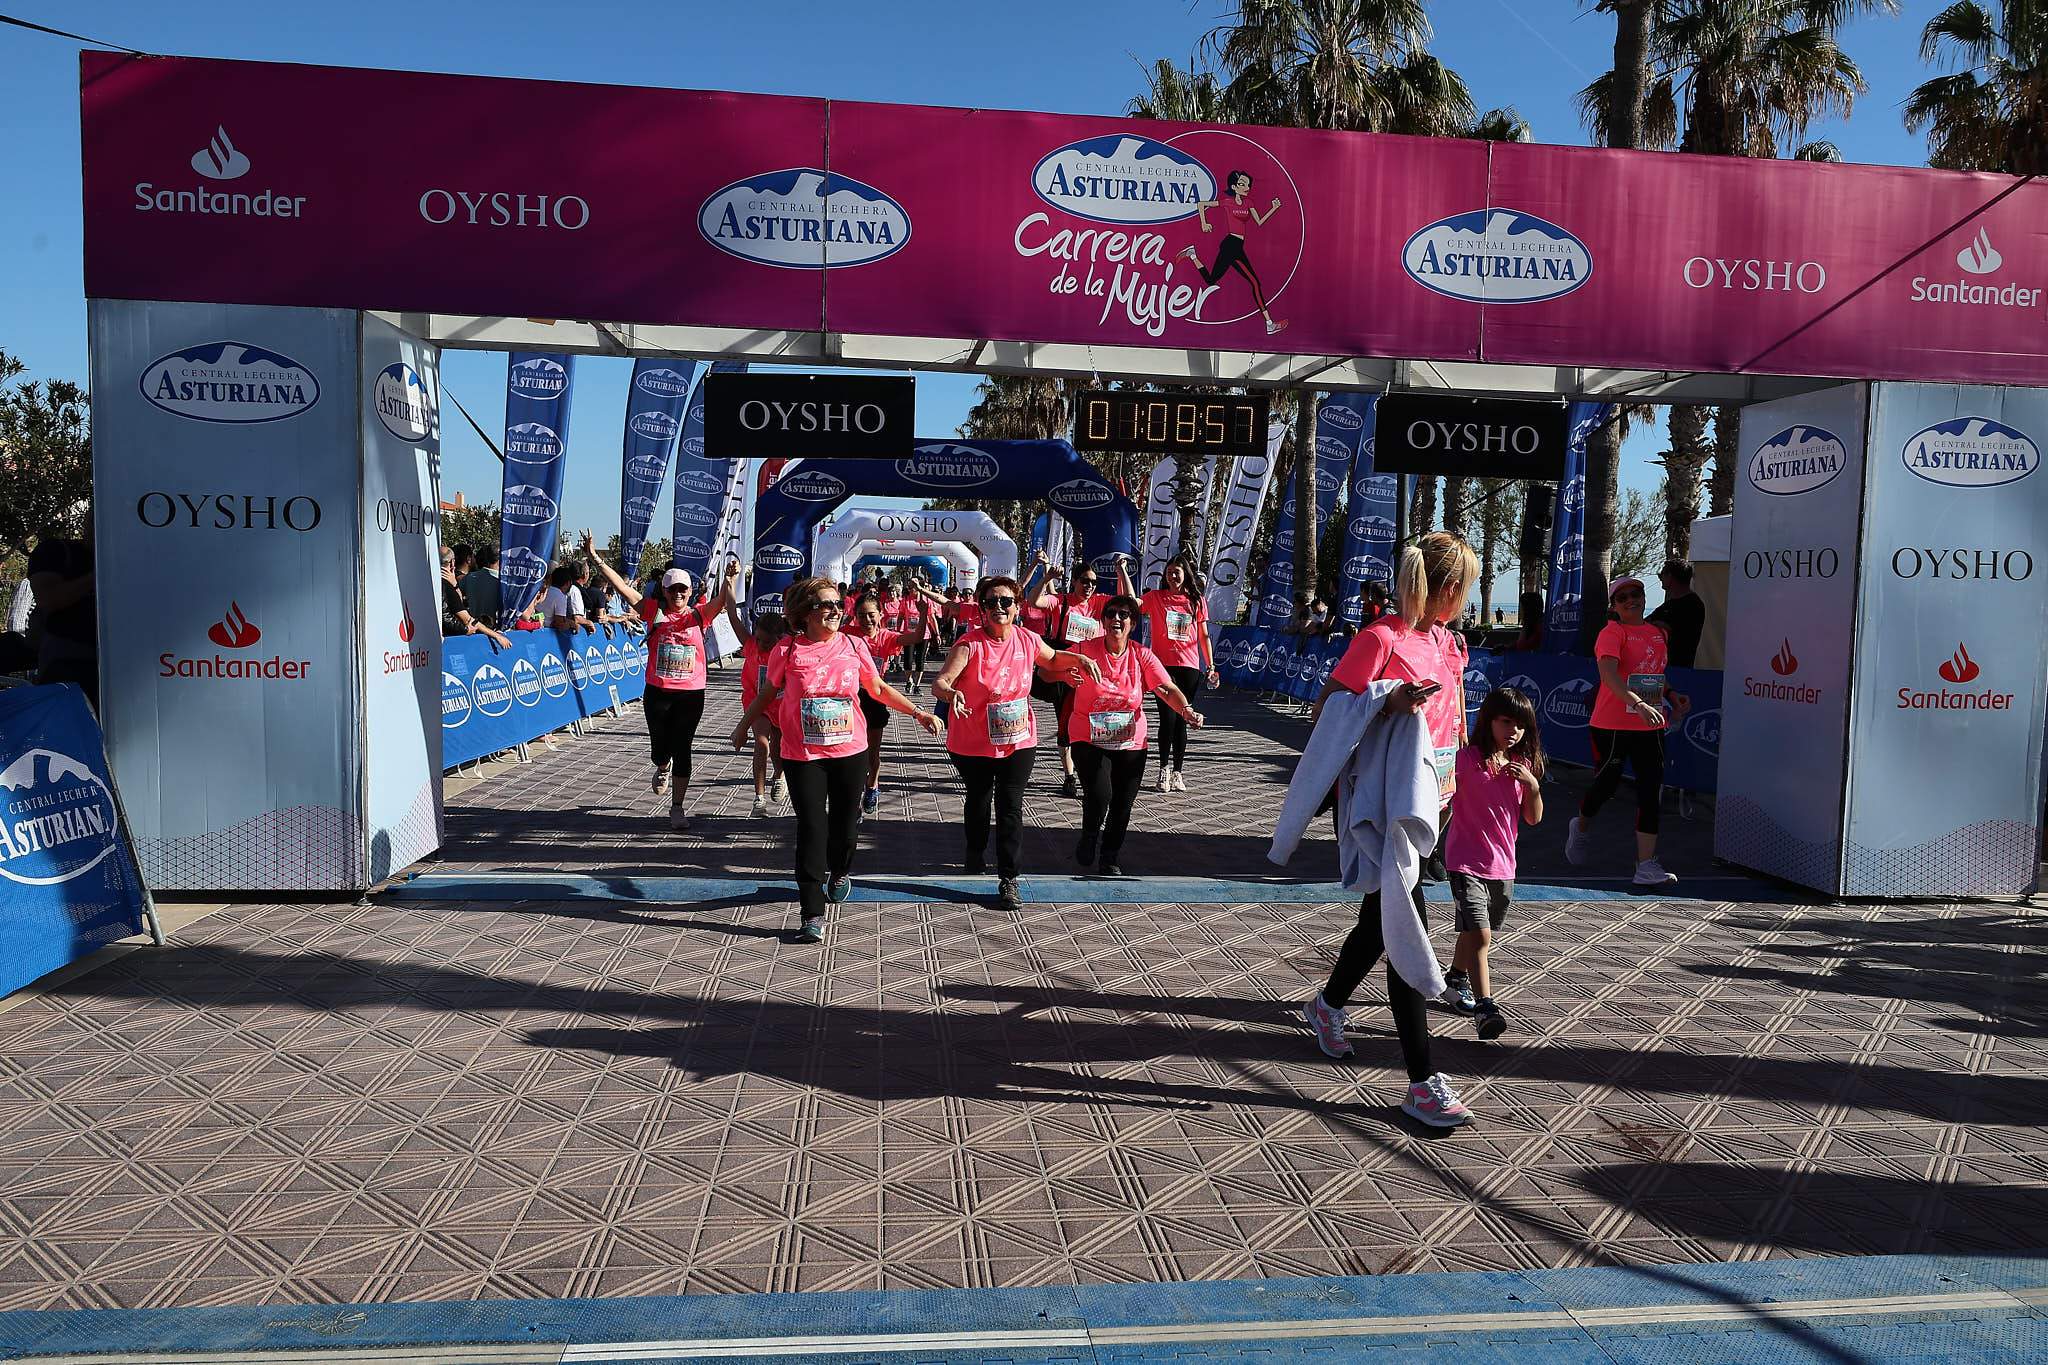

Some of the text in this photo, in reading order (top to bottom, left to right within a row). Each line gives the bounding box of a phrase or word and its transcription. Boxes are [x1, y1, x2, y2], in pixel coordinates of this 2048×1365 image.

[1046, 162, 1201, 204] ASTURIANA
[1075, 162, 1198, 178] CENTRAL LECHERA
[135, 183, 306, 217] Santander
[419, 189, 590, 230] OYSHO
[748, 201, 815, 213] CENTRAL
[714, 201, 895, 245] ASTURIANA
[1014, 212, 1168, 266] Carrera
[1447, 239, 1573, 254] CENTRAL LECHERA
[1416, 239, 1577, 281] ASTURIANA
[1683, 257, 1827, 293] OYSHO
[1049, 261, 1221, 337] de la Mujer
[1911, 276, 2041, 307] Santander
[154, 369, 307, 405] ASTURIANA
[181, 368, 302, 381] CENTRAL LECHERA
[640, 376, 686, 394] ASTURIANA
[378, 384, 430, 428] ASTURIANA
[739, 400, 886, 434] OYSHO
[1089, 400, 1254, 444] 01:08:57
[1407, 420, 1540, 454] OYSHO
[1768, 444, 1836, 460] CENTRAL LECHERA
[1912, 441, 2028, 471] ASTURIANA
[1934, 440, 2026, 450] CENTRAL LECHERA
[902, 459, 992, 478] ASTURIANA
[1753, 454, 1838, 482] ASTURIANA
[784, 481, 840, 496] ASTURIANA
[1054, 488, 1110, 502] ASTURIANA
[137, 491, 321, 532] OYSHO
[376, 497, 434, 537] OYSHO
[877, 515, 958, 534] OYSHO
[1212, 456, 1269, 587] OYSHO
[677, 544, 708, 556] STURIANA
[757, 553, 801, 566] ASTURIANA
[1743, 547, 1839, 579] OYSHO
[1891, 547, 2033, 581] OYSHO
[755, 603, 784, 614] ASTURI
[159, 653, 311, 679] Santander
[383, 649, 430, 675] Santander
[476, 685, 512, 706] ASTURIANA
[1743, 677, 1822, 705] Santander
[1897, 687, 2014, 710] Santander
[9, 785, 102, 815] CENTRAL LECHER
